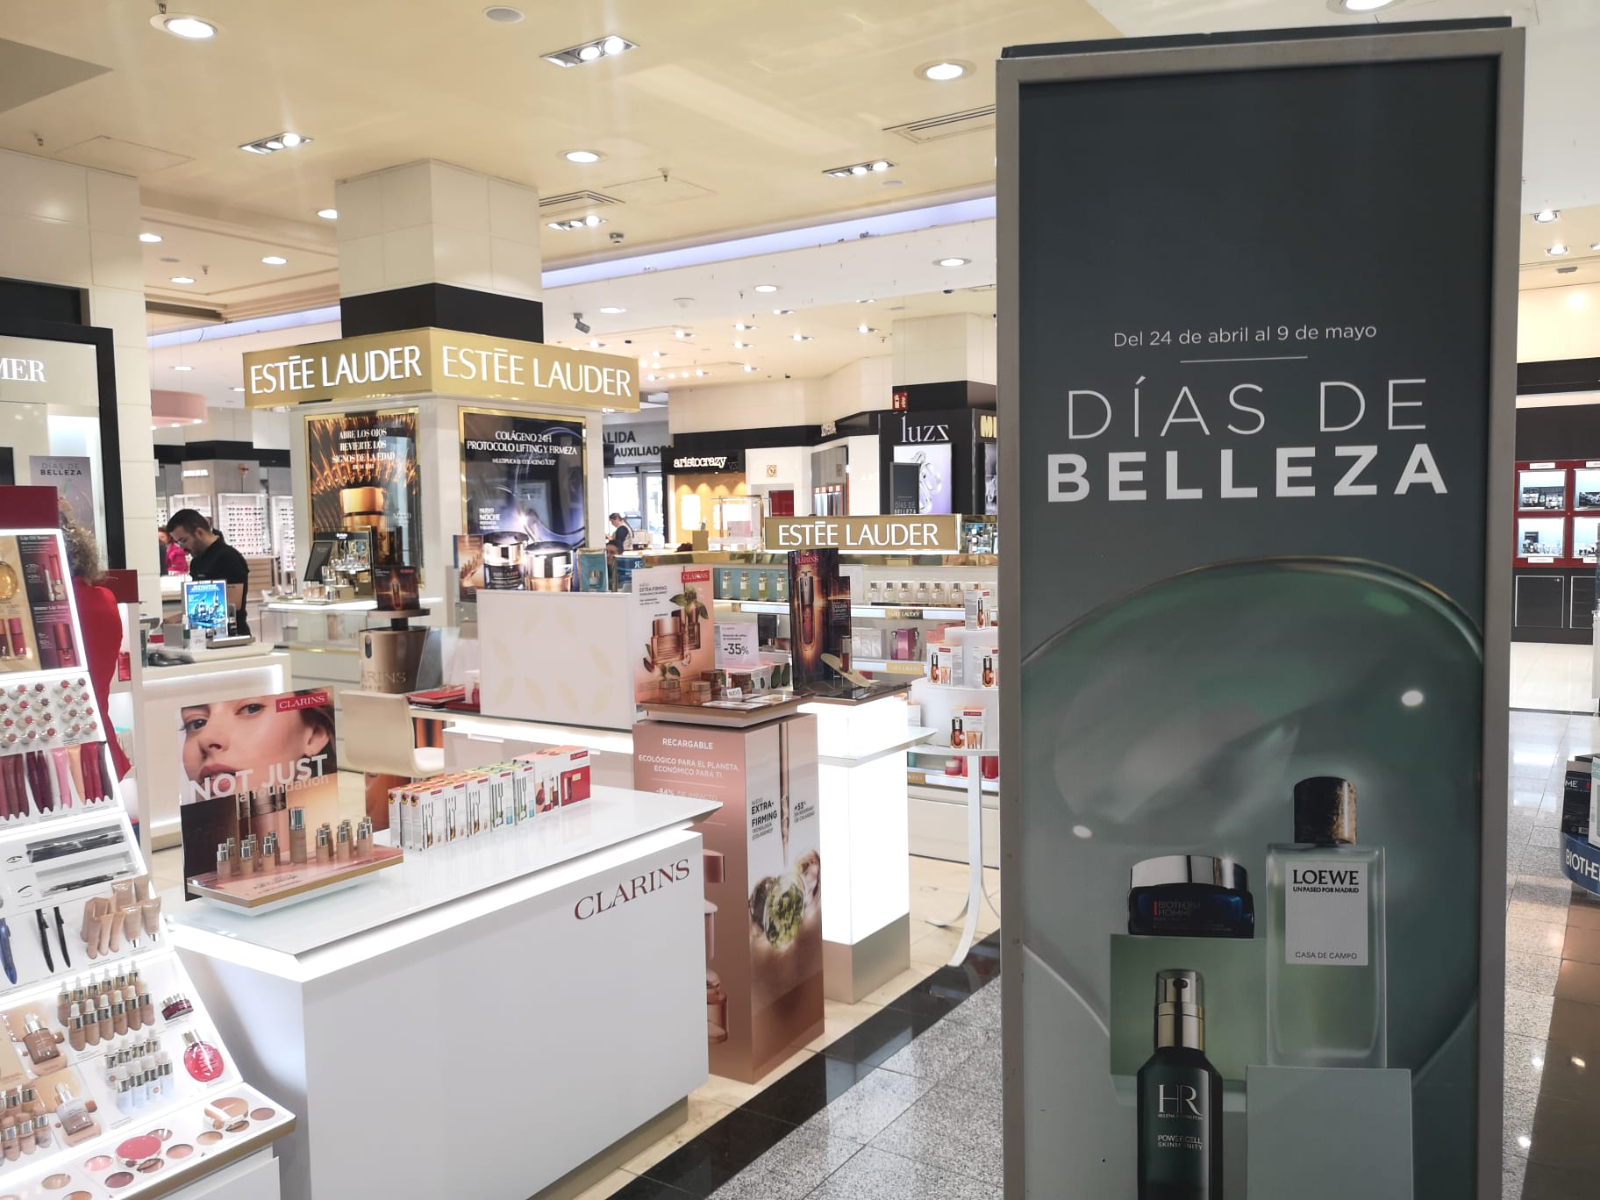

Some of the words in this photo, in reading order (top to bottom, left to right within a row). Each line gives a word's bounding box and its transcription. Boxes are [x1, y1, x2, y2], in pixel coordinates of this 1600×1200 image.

[1113, 331, 1144, 348] Del
[1149, 331, 1173, 346] 24
[1178, 329, 1202, 346] de
[1208, 327, 1250, 344] abril
[1255, 326, 1271, 342] al
[1277, 326, 1290, 341] 9
[1295, 325, 1320, 341] de
[1325, 325, 1378, 342] mayo
[321, 345, 423, 388] LAUDER
[533, 357, 632, 397] LAUDER
[1068, 375, 1266, 439] DÍAS
[1319, 378, 1427, 432] DE
[339, 429, 356, 440] ABRE
[356, 428, 370, 439] LOS
[370, 427, 387, 437] OJOS
[495, 430, 538, 443] COLÁGENO
[339, 440, 373, 452] REVIERTE
[373, 439, 387, 450] LOS
[466, 440, 515, 453] PROTOCOLO
[515, 443, 542, 454] LIFTING
[541, 445, 549, 454] Y
[549, 446, 578, 455] FIRMEZA
[332, 453, 356, 464] SIGNOS
[356, 453, 367, 463] DE
[376, 451, 396, 462] EDAD
[673, 456, 728, 469] aristocrazy
[67, 462, 80, 470] DE
[1047, 443, 1449, 503] BELLEZA
[845, 523, 940, 546] LAUDER
[723, 643, 750, 656] -35%
[278, 694, 327, 709] CLARINS
[661, 737, 714, 750] RECARGABLE
[638, 754, 677, 766] ECOLÓGICO
[677, 757, 696, 767] PARA
[697, 760, 706, 768] EL
[188, 768, 254, 805] NOT
[261, 753, 329, 787] JUST
[653, 765, 695, 777] ECONÓMICO
[695, 769, 715, 778] PARA
[239, 792, 246, 803] a
[249, 774, 330, 800] foundation
[751, 800, 775, 815] EXTRA-
[751, 810, 778, 828] FIRMING
[1565, 848, 1600, 882] BIOTHE
[1292, 869, 1360, 887] LOEWE
[573, 857, 691, 921] CLARINS
[1292, 885, 1303, 893] UN
[1334, 886, 1360, 894] MADRID
[1295, 950, 1317, 959] CASA
[1317, 951, 1329, 960] DE
[1329, 952, 1358, 961] CAMPO
[1157, 1083, 1203, 1116] HR
[1157, 1141, 1203, 1151] SKINMNITY
